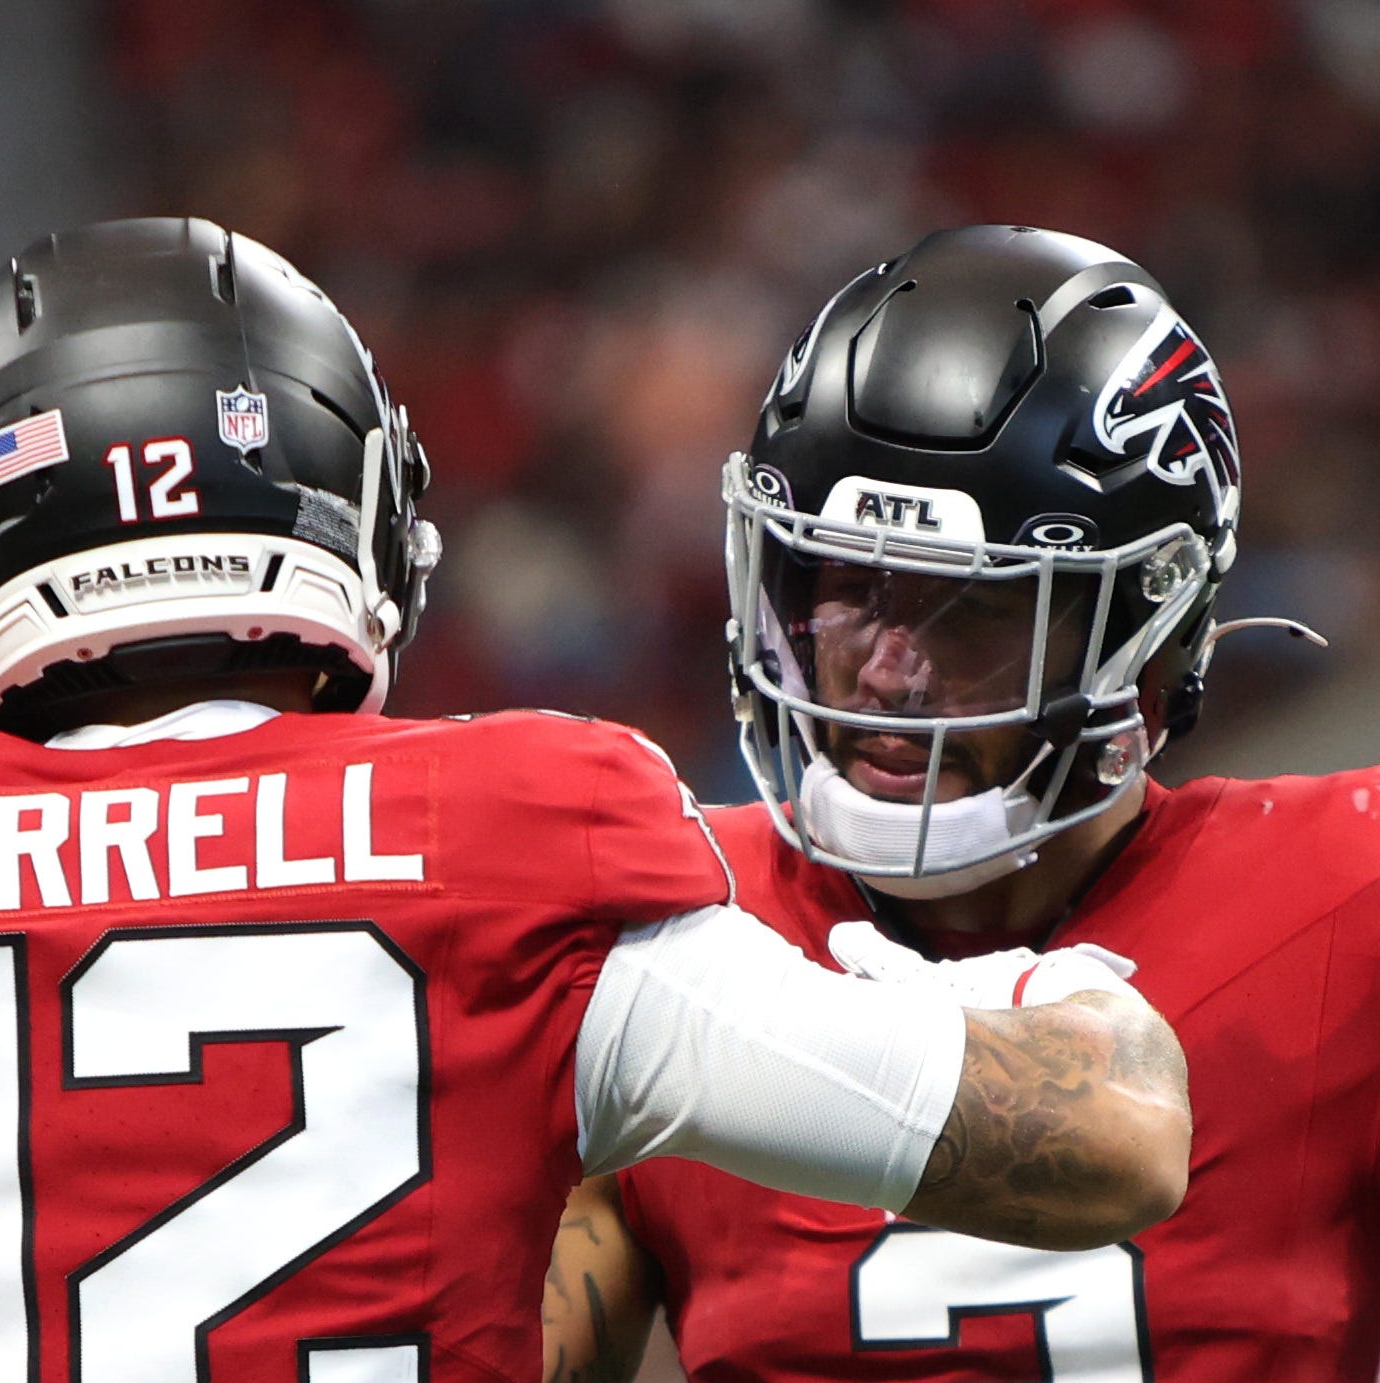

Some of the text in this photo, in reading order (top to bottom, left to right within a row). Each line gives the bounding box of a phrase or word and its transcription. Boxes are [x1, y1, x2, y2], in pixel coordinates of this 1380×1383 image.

[226, 415, 262, 441] NFL
[102, 435, 202, 524] 12
[855, 489, 941, 529] ATL
[71, 555, 250, 590] FALCONS
